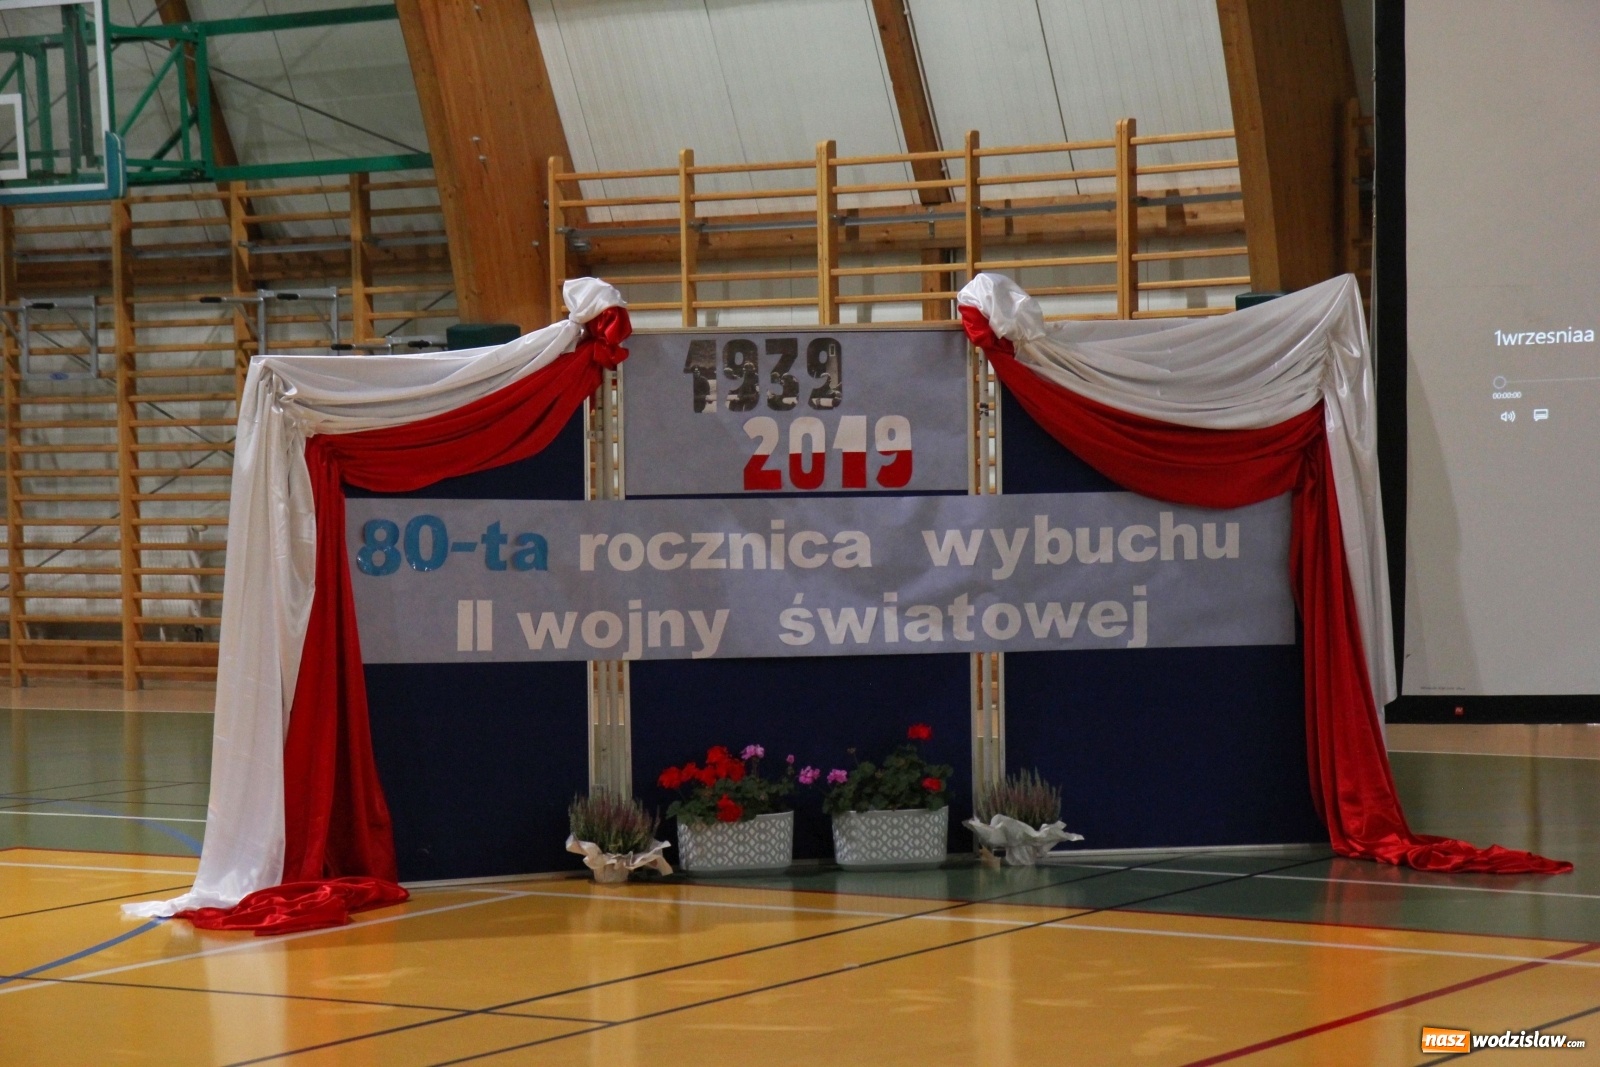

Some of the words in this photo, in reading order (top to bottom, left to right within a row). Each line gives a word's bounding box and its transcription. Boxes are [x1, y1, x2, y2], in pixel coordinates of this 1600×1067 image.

[1494, 326, 1595, 346] 1wrzesniaa
[683, 337, 843, 413] 1939
[743, 415, 913, 490] 2019
[356, 514, 548, 577] 80-ta
[579, 519, 872, 572] rocznica
[922, 511, 1240, 580] wybuchu
[457, 600, 493, 652] II
[516, 599, 730, 660] wojny
[778, 585, 1148, 648] światowej
